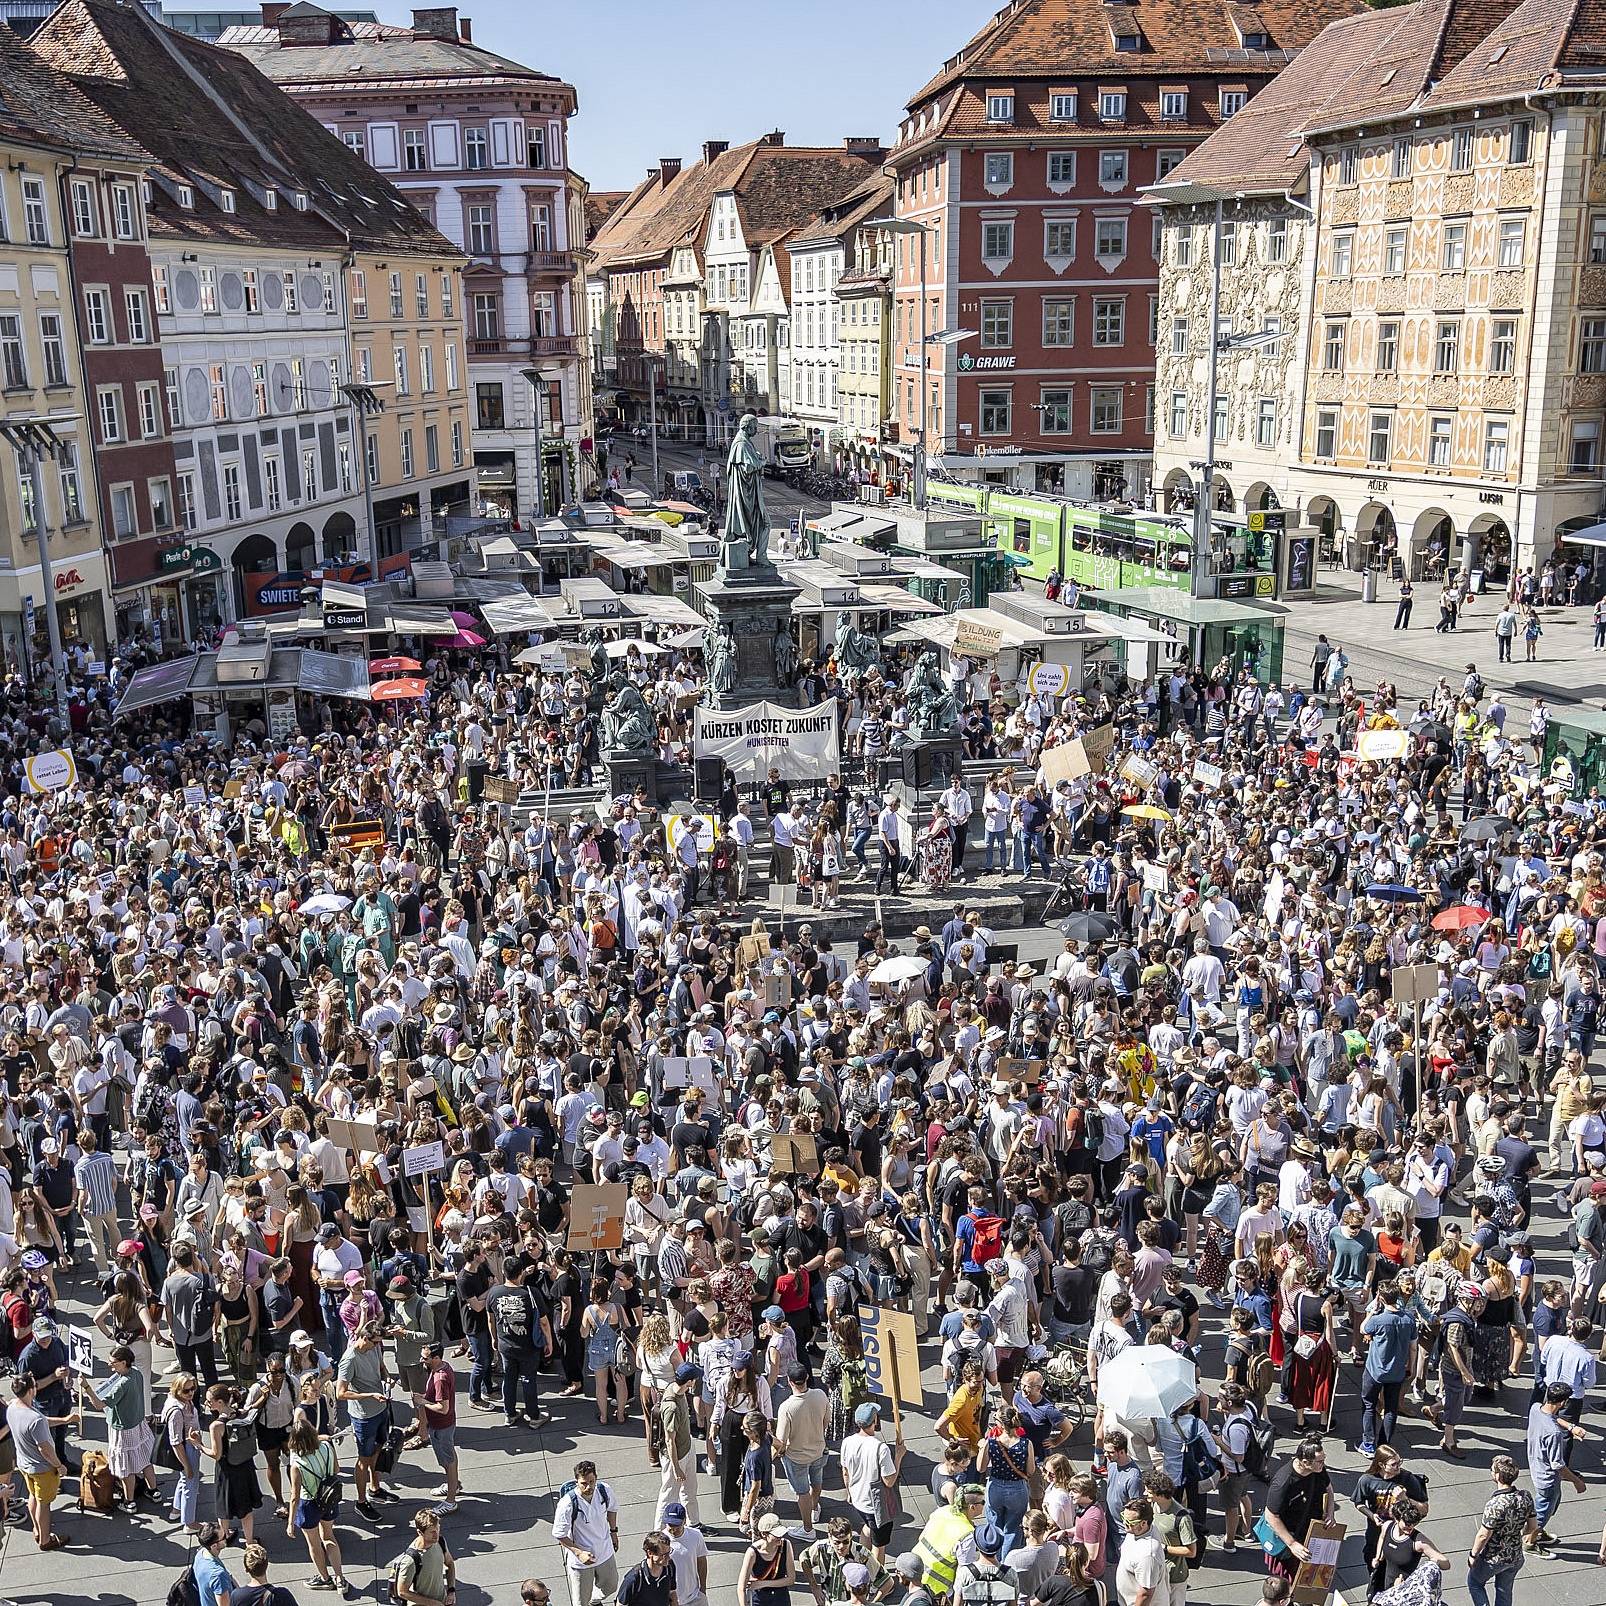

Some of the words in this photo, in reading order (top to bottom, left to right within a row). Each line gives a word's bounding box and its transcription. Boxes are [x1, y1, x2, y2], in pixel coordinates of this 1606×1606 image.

[962, 303, 978, 312] 111
[976, 356, 1016, 368] GRAWE
[974, 444, 1023, 455] hnkemöller
[1479, 492, 1504, 505] LUSH
[604, 514, 610, 522] 2
[559, 532, 565, 540] 3
[705, 545, 717, 554] 10
[509, 557, 515, 565] 4
[881, 562, 887, 571] 8
[841, 591, 855, 601] 14
[601, 604, 615, 613] 12
[337, 615, 363, 624] Standl
[1065, 620, 1080, 631] 15
[961, 623, 1001, 638] BILDUNG
[251, 667, 259, 678] 7
[701, 721, 743, 739] KÜRZEN
[746, 719, 783, 734] KOSTET
[786, 716, 832, 733] ZUKUNFT
